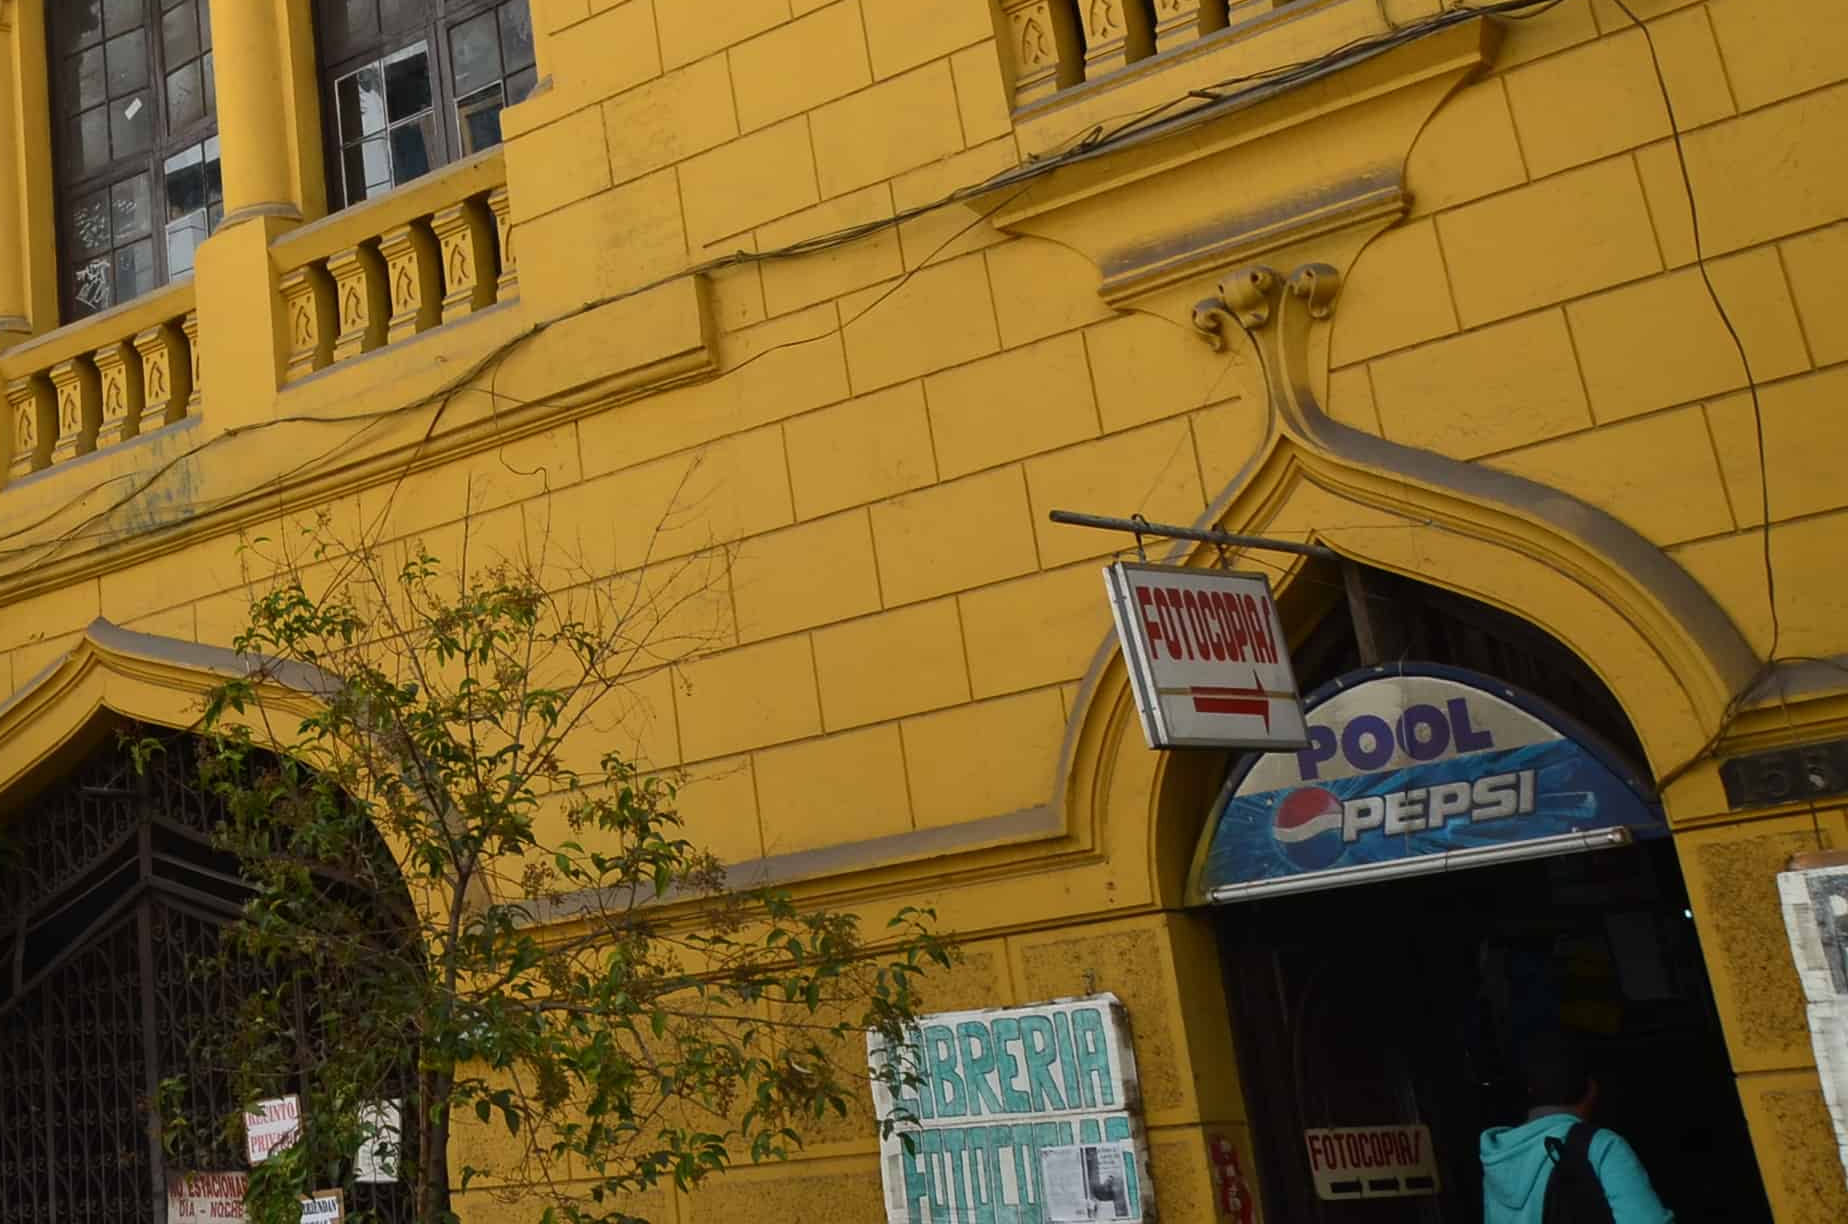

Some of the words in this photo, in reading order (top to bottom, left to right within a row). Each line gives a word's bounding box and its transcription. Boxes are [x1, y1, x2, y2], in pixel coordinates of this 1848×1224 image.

[1135, 584, 1278, 664] FOTOCOPIAS
[1297, 697, 1493, 781] POOL
[1343, 769, 1536, 842] PEPSI
[1308, 1130, 1421, 1171] FOTOCOPIAS
[210, 1200, 243, 1217] NOCHE
